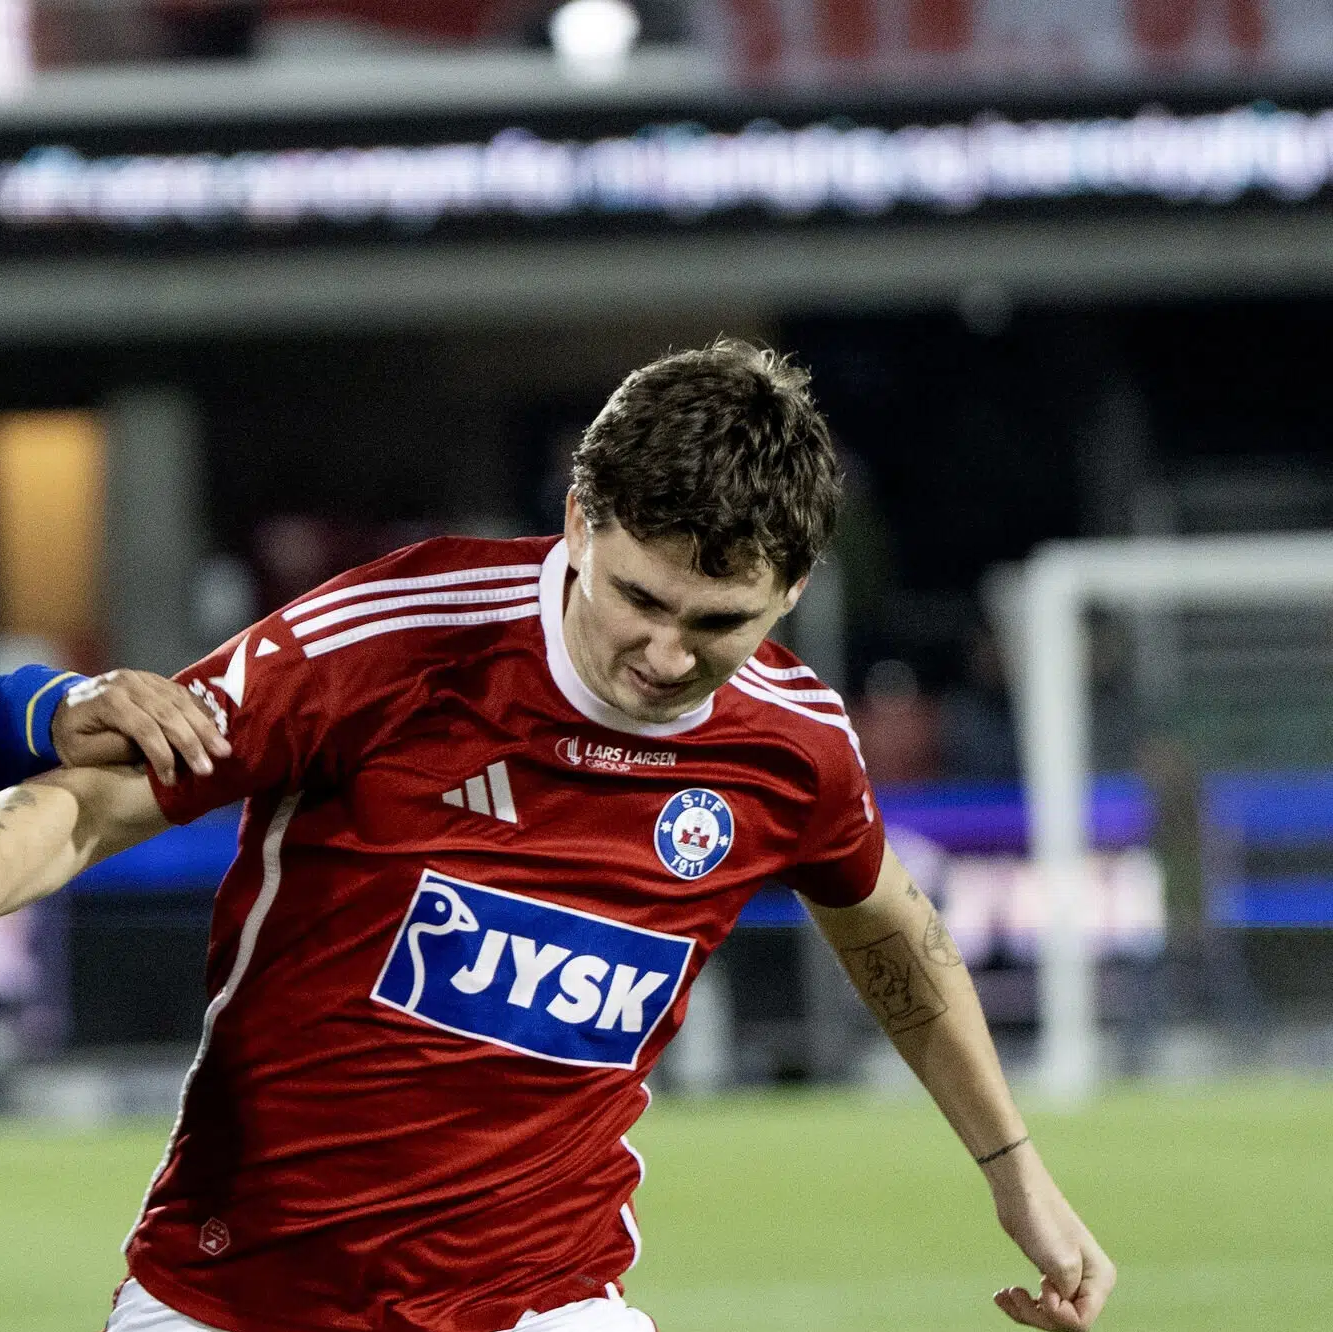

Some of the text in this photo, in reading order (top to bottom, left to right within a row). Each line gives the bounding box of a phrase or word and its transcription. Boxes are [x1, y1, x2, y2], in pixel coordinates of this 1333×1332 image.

[585, 742, 677, 766] LARS LARSEN
[585, 758, 631, 772] GROUP
[670, 854, 705, 877] 1917
[449, 928, 670, 1033] JYSK
